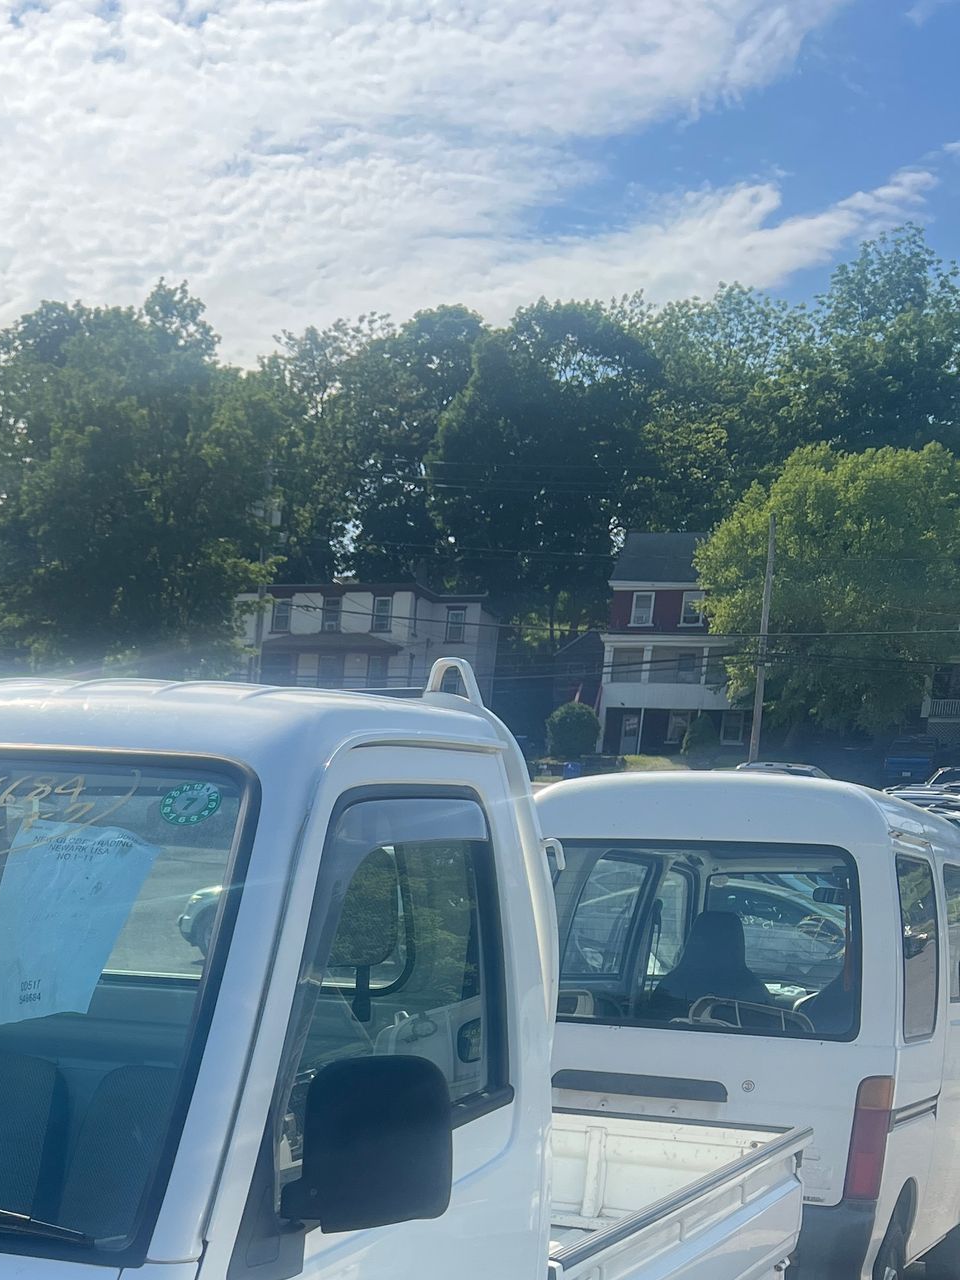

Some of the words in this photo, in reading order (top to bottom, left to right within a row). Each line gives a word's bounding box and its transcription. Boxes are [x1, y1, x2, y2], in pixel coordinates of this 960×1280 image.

[182, 797, 199, 811] 7
[48, 843, 87, 853] NEWARK
[90, 847, 109, 855] USA
